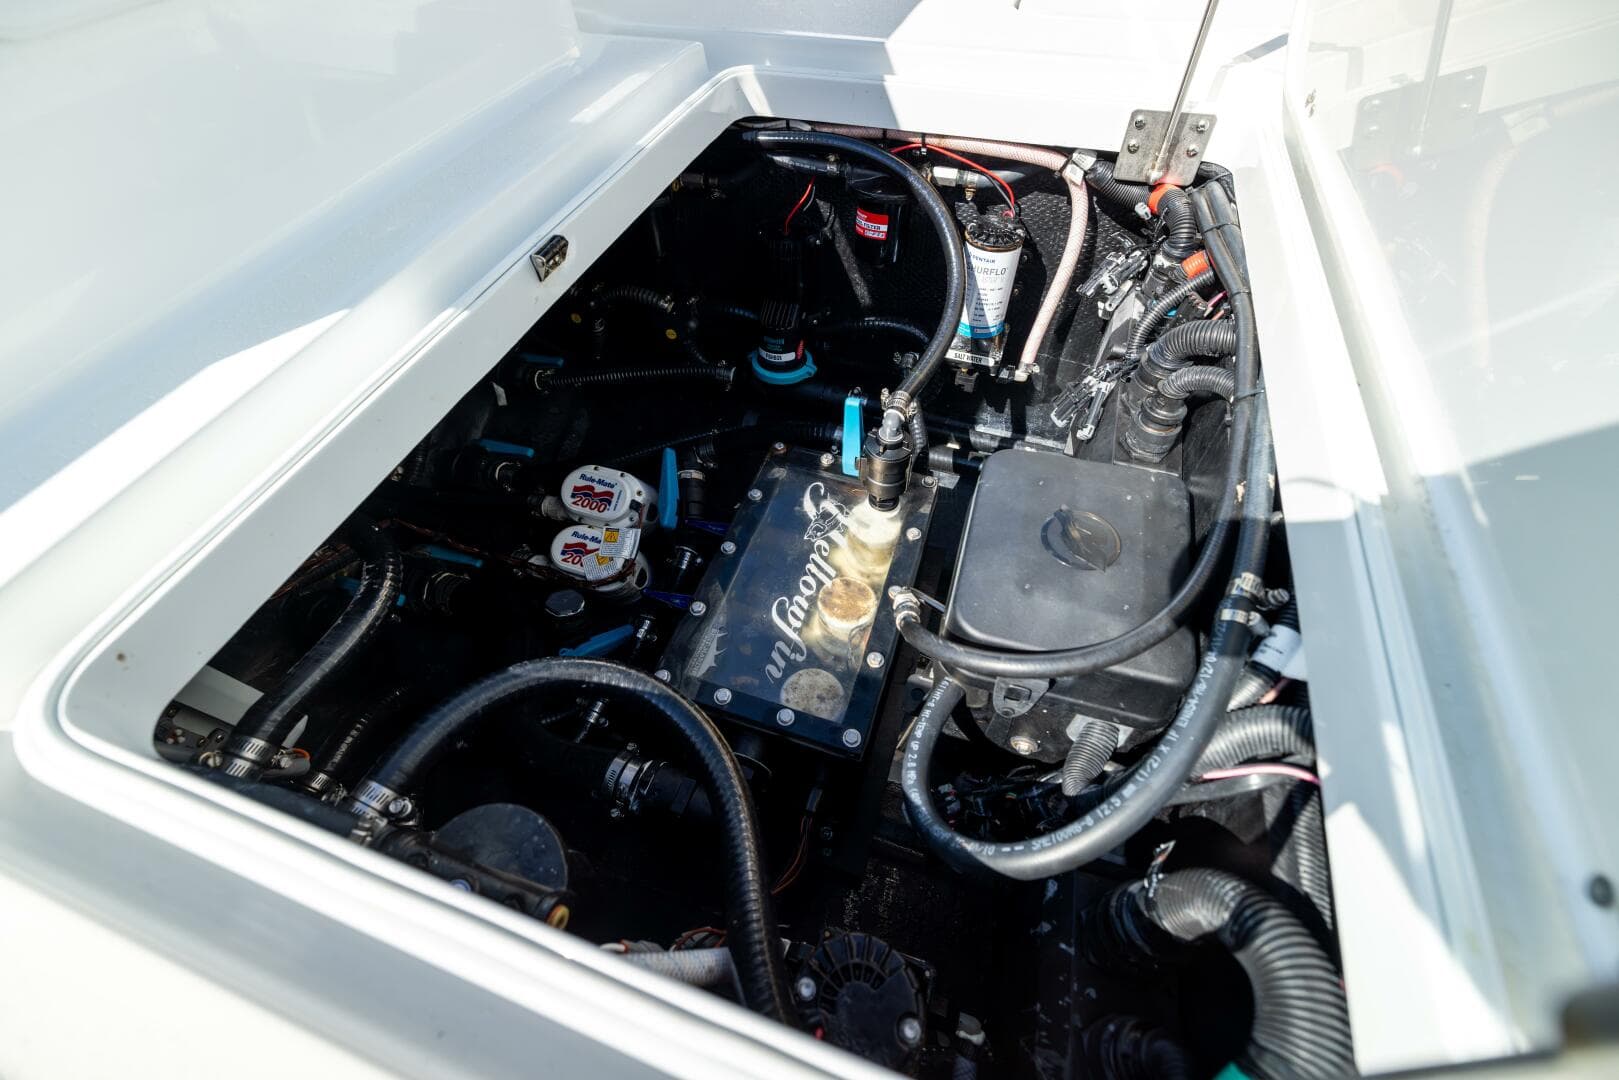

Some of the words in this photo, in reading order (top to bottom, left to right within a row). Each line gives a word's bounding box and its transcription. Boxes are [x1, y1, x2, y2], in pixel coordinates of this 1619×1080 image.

[954, 352, 966, 360] SALT
[966, 354, 983, 364] WATER
[579, 473, 617, 489] Rule-Mate
[571, 495, 608, 514] 2000
[560, 551, 584, 568] 20
[1096, 797, 1122, 819] 12.5
